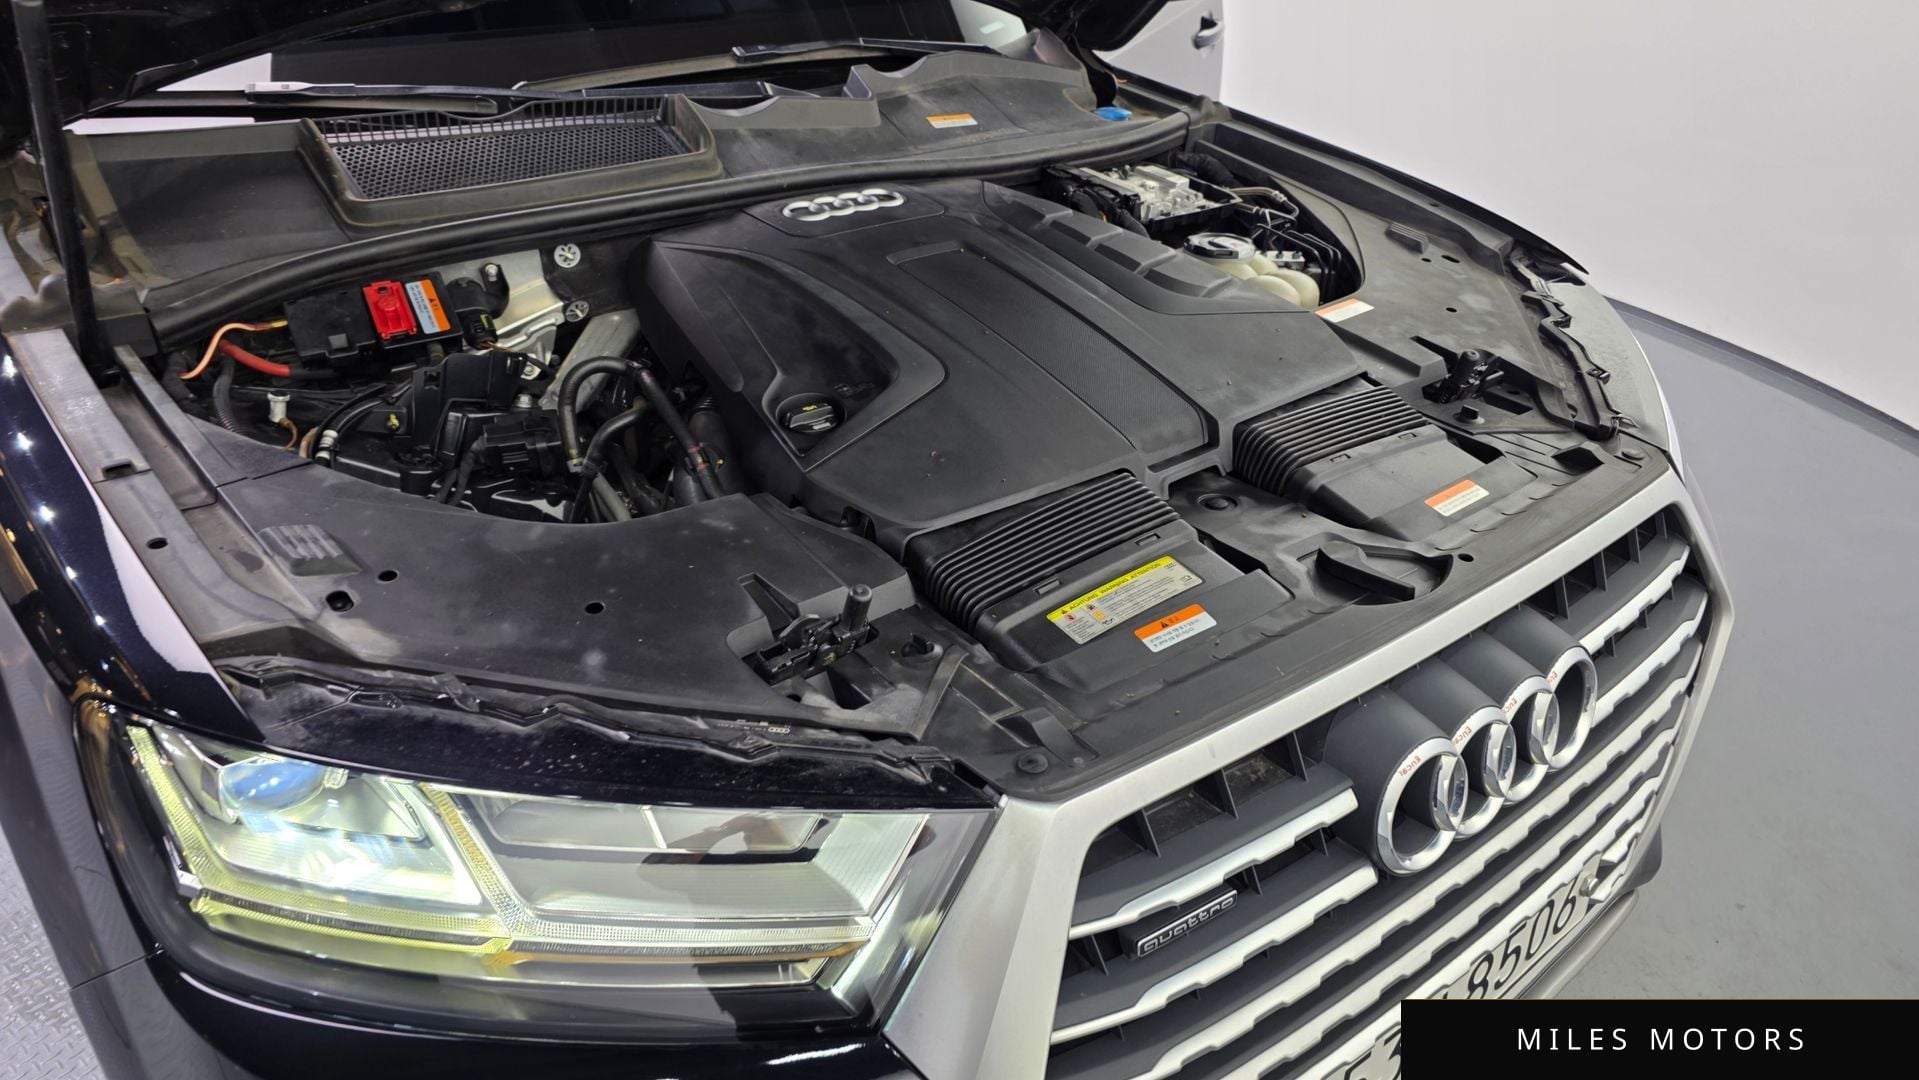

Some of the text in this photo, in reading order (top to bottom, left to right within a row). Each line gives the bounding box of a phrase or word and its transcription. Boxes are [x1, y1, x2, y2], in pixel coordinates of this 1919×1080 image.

[1069, 563, 1161, 611] ACHTUNG WARNING ATTENTION
[1144, 897, 1233, 952] quattro
